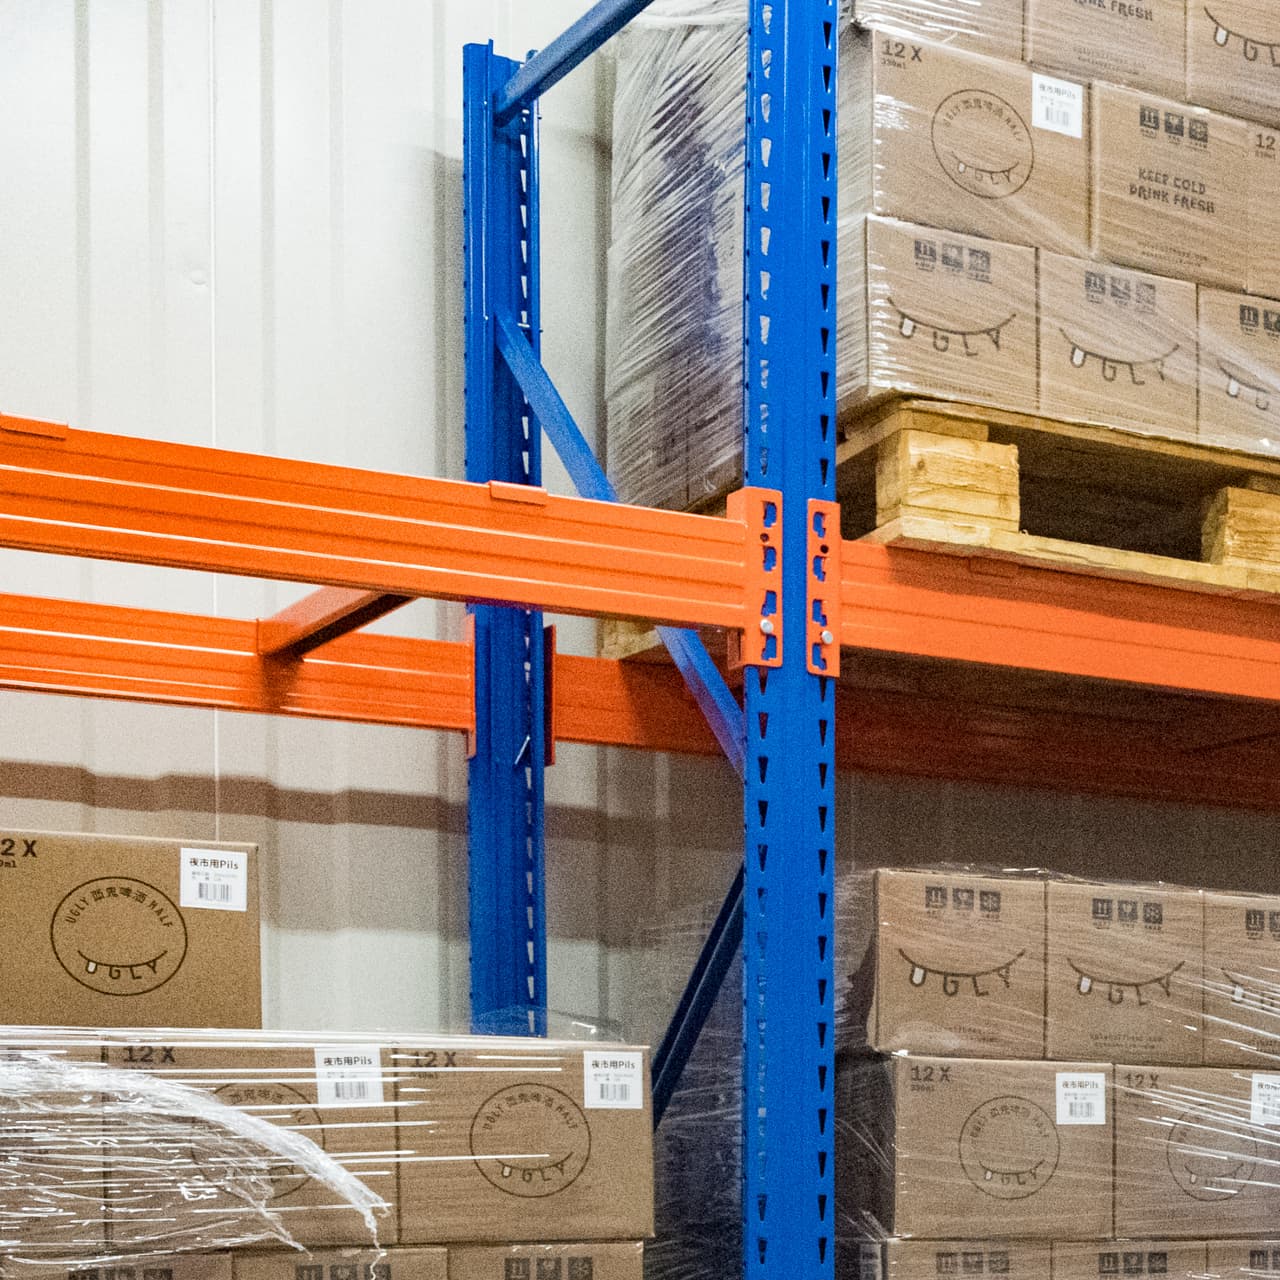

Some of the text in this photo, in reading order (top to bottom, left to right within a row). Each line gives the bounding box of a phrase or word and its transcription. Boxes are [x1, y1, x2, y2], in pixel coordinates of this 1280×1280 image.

[0, 839, 38, 858] 2 X
[66, 898, 90, 924] UGLY
[147, 901, 173, 928] HALF
[86, 960, 158, 980] UGLY
[910, 966, 1010, 997] UGLY
[1077, 975, 1171, 1006] UGLY
[501, 1163, 564, 1182] UGLY
